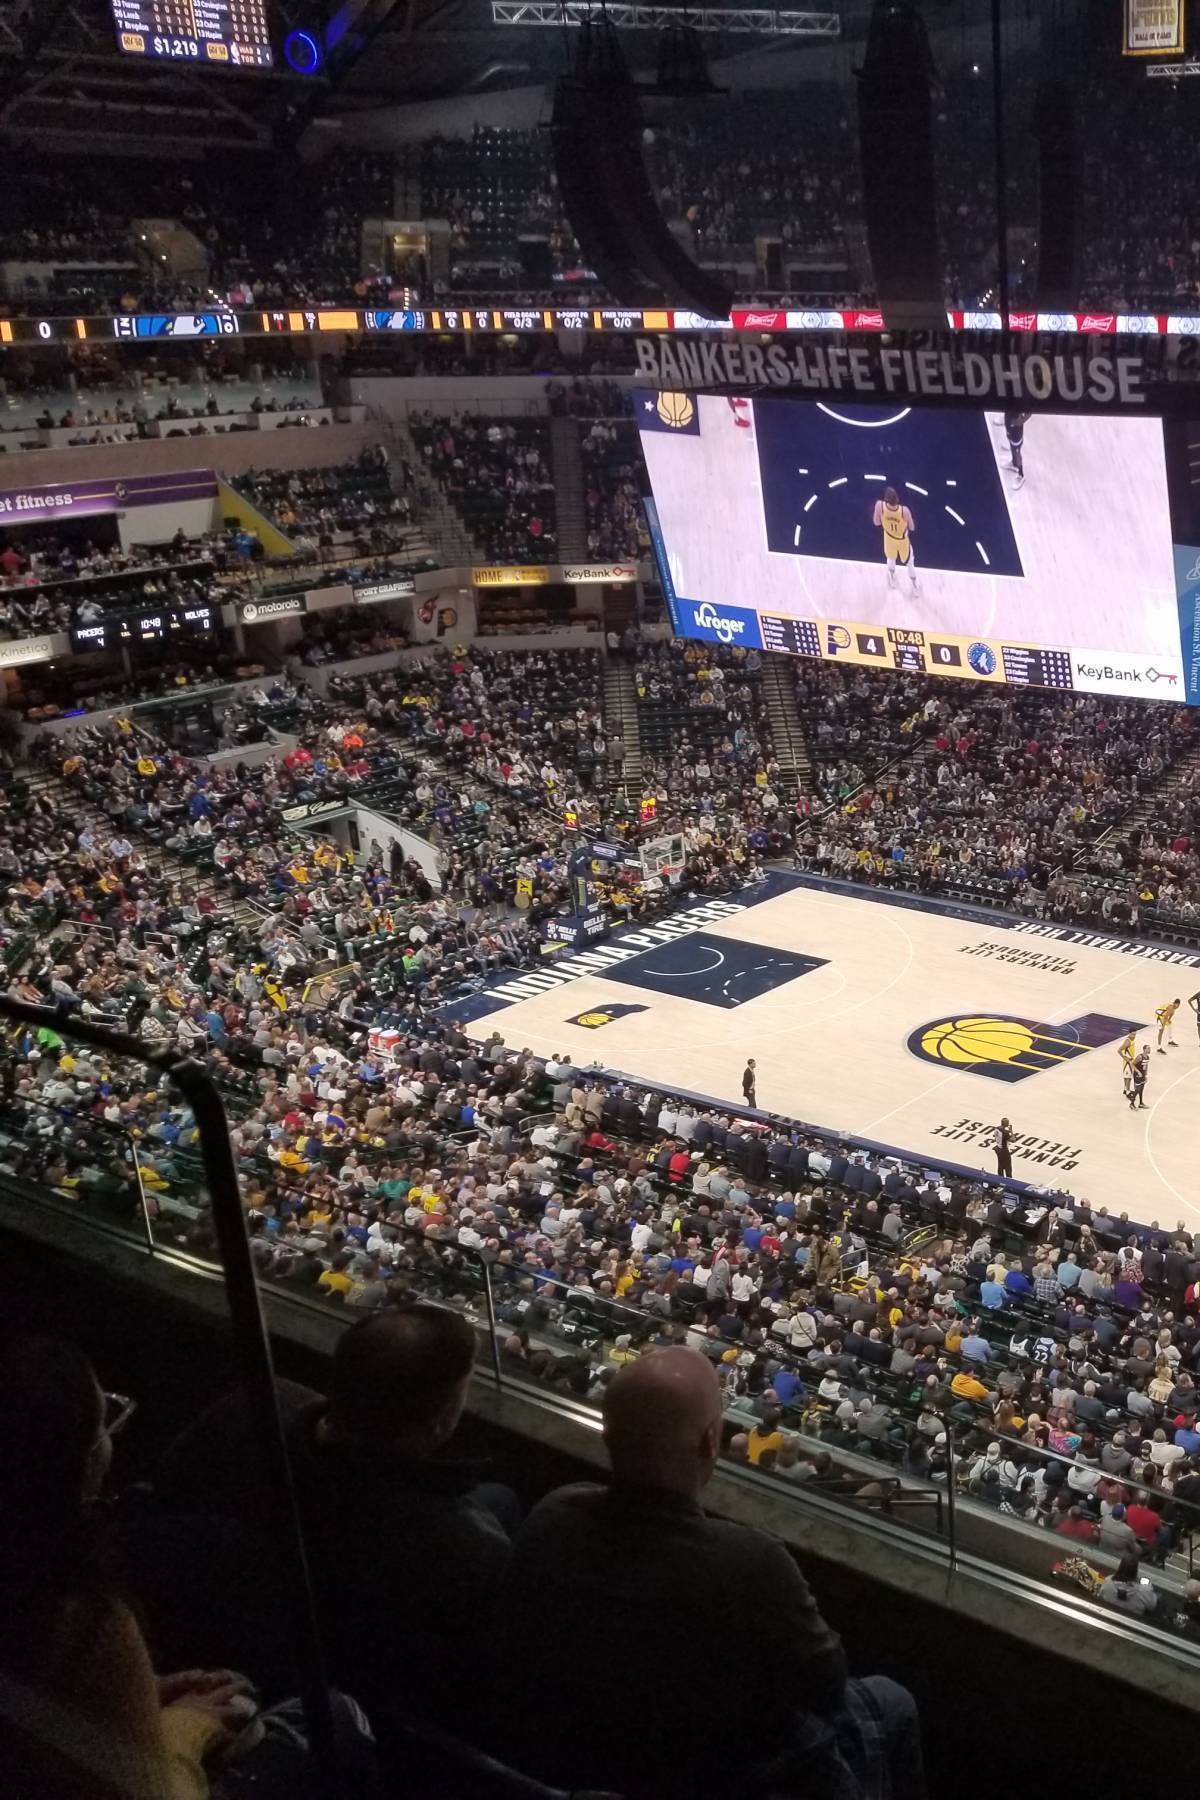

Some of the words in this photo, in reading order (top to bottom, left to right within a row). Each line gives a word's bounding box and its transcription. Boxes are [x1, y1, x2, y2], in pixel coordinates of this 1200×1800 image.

[154, 36, 198, 57] $1,219
[39, 321, 51, 339] 0
[447, 318, 456, 328] 0
[478, 318, 486, 328] 0
[513, 318, 532, 328] 0/3
[563, 318, 583, 328] 0/2
[613, 318, 632, 328] 0/0
[635, 338, 791, 388] BANKERS
[797, 345, 876, 391] LIFE
[880, 349, 1146, 403] FIELDHOUSE
[16, 492, 73, 510] fitness
[475, 571, 502, 583] HOME
[564, 569, 610, 580] KeyBank
[258, 600, 300, 615] motorola
[140, 617, 161, 630] 10:48
[693, 602, 745, 643] Kroger
[889, 629, 924, 645] 10:48
[866, 638, 877, 653] 4
[940, 647, 951, 663] 0
[1077, 663, 1143, 683] KeyBank
[583, 913, 607, 929] BELLE
[587, 922, 605, 936] TIRE
[558, 926, 577, 934] BELLE
[560, 933, 574, 942] TIRE
[1009, 921, 1067, 939] HERE
[484, 944, 640, 1003] INDIANA
[618, 898, 748, 948] PACERS
[956, 945, 995, 957] LIFE
[976, 941, 1078, 967] FIELDHOUSE
[1067, 932, 1200, 968] BASKETBALL
[996, 954, 1075, 975] BANKERS
[930, 1125, 977, 1143] LIFE
[953, 1118, 1083, 1159] FIELDHUSE
[978, 1139, 1080, 1171] BANKES
[1034, 1350, 1048, 1364] 22
